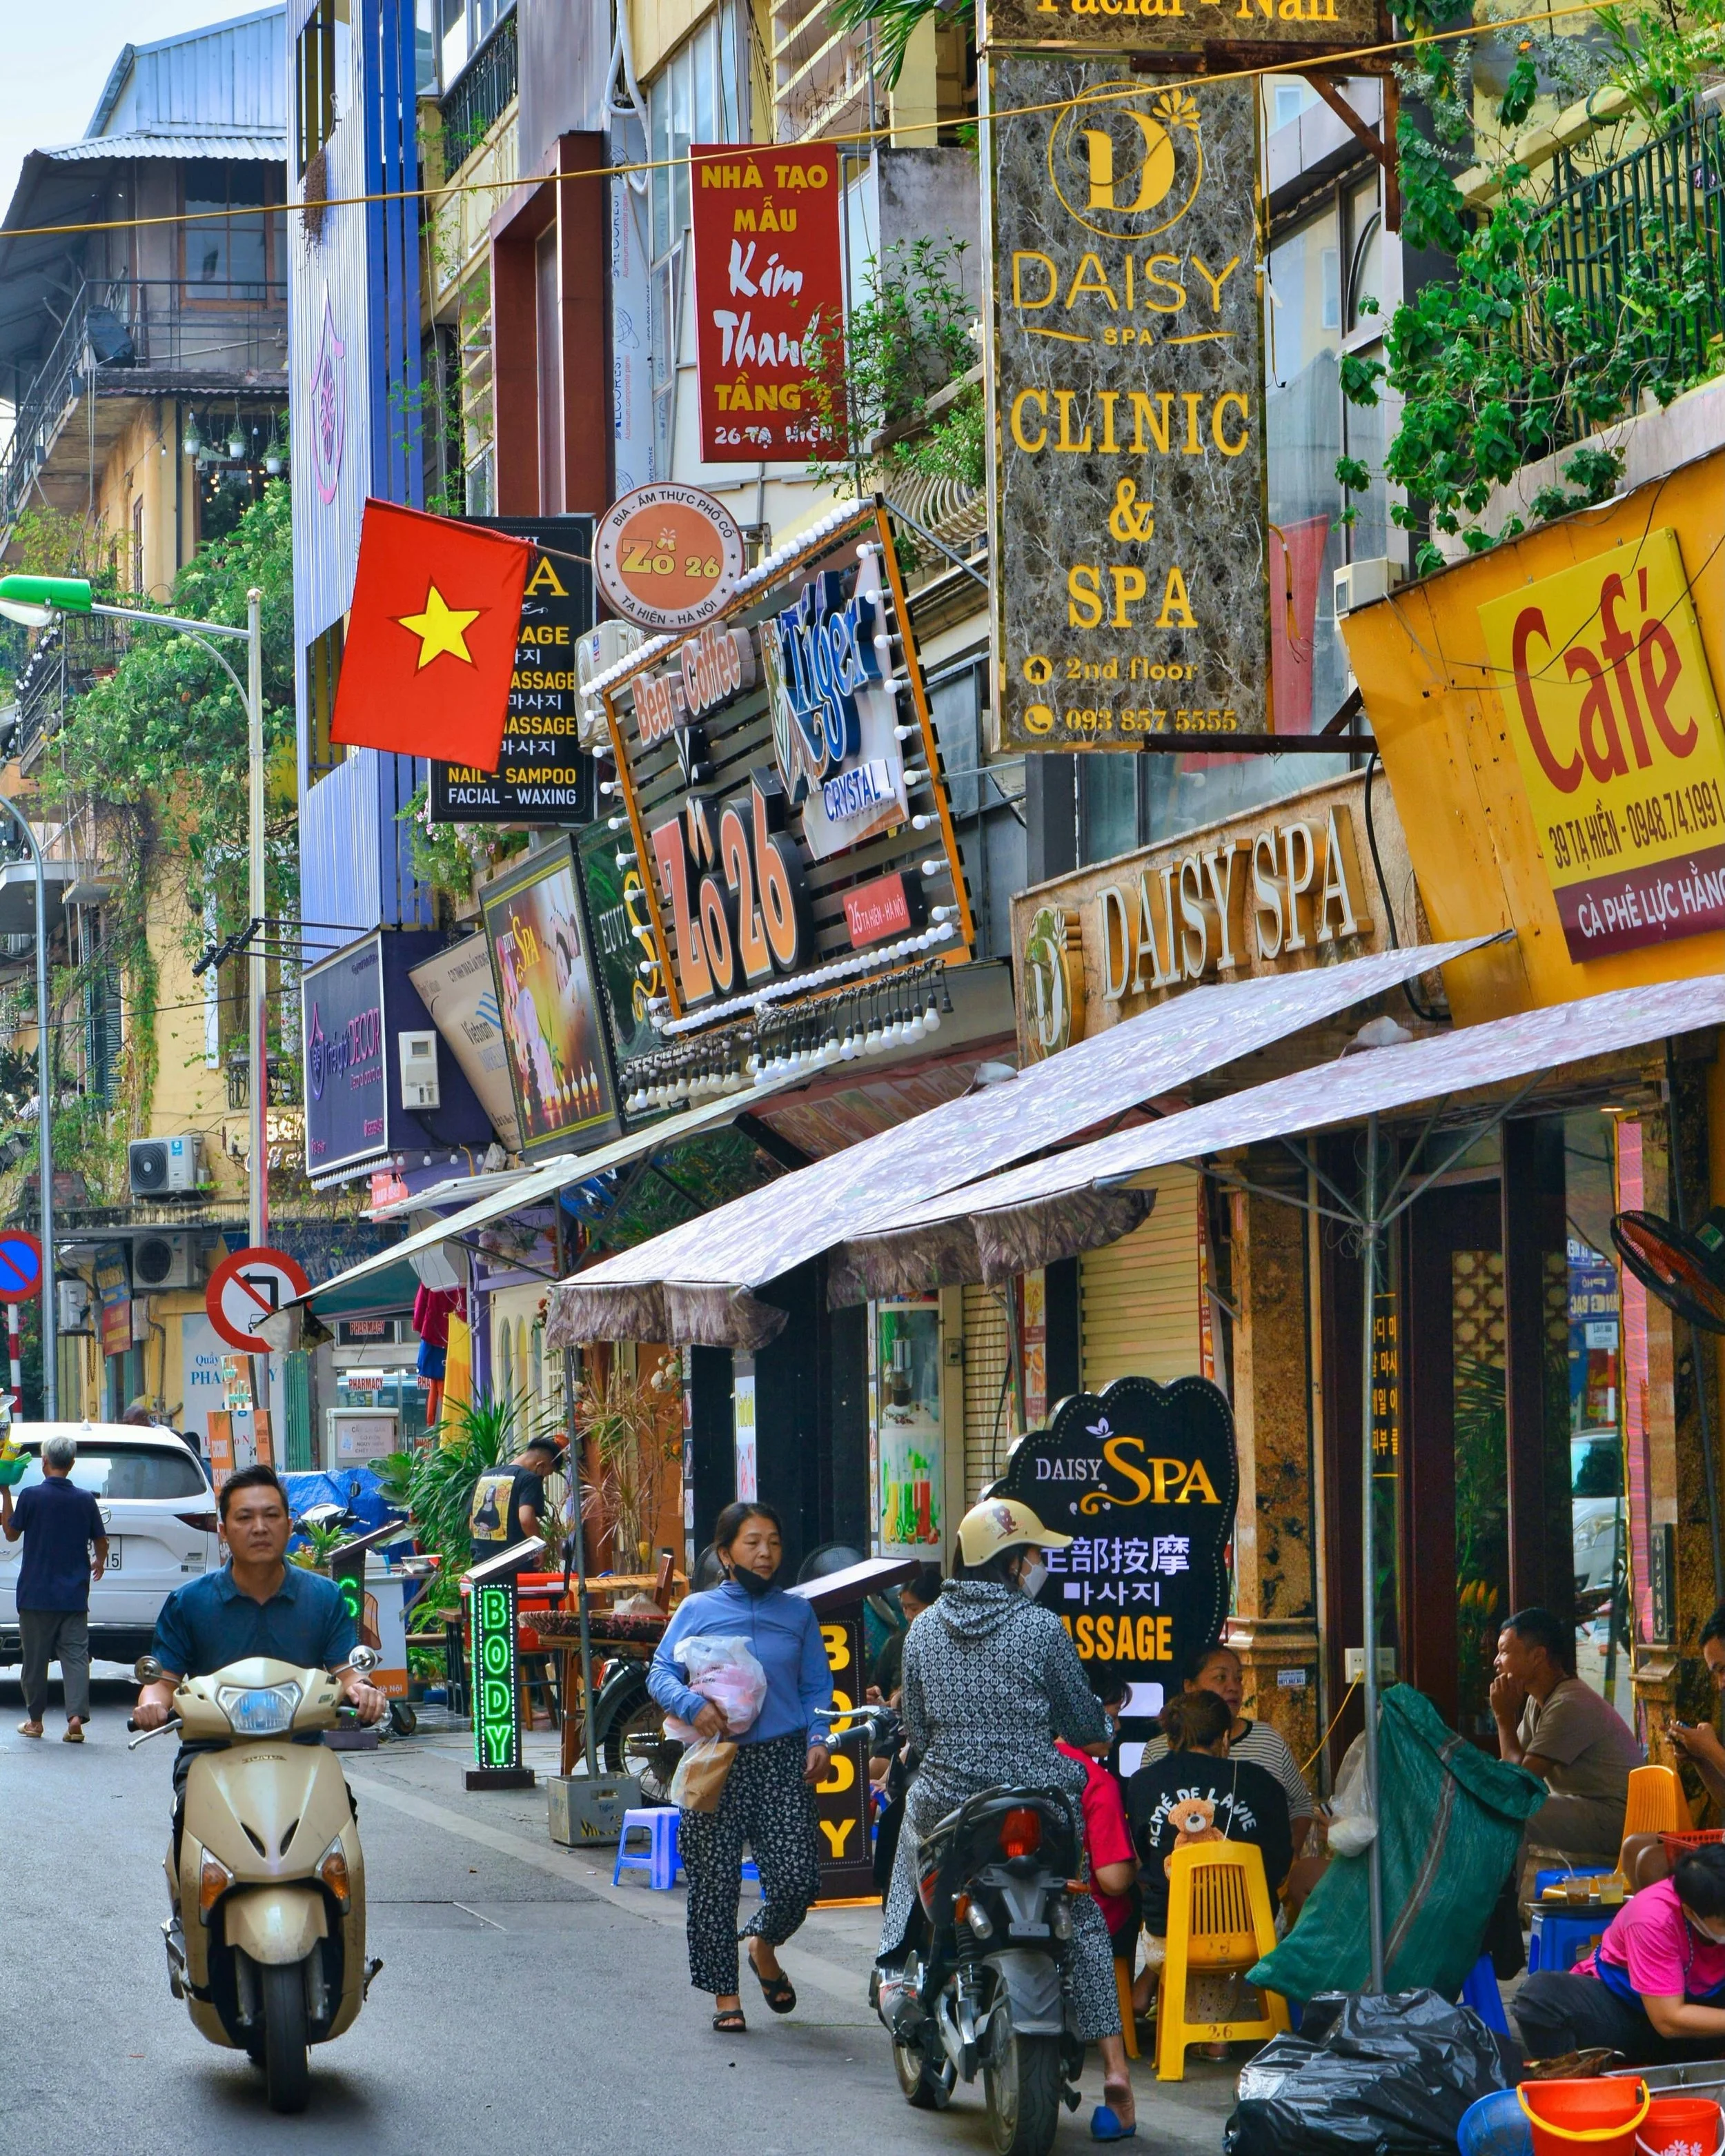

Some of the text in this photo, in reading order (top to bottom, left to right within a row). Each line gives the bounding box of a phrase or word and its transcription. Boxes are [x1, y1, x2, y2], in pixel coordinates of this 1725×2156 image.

[701, 157, 828, 194] NHÀ TẠO
[733, 195, 797, 232] MẪU
[1012, 250, 1240, 314] DAISY
[1103, 327, 1153, 346] SPA
[713, 371, 801, 411] TẦNG
[715, 426, 741, 445] 26
[1011, 389, 1249, 457] CLINIC
[612, 508, 631, 527] BIA
[659, 491, 696, 505] THỰC
[697, 500, 724, 520] PHỐ
[718, 521, 736, 538] CỔ
[1109, 477, 1154, 543] &
[684, 555, 721, 579] 26
[622, 595, 634, 613] TẠ
[637, 608, 666, 624] HIỆN
[678, 612, 696, 624] HÀ
[696, 600, 718, 618] NỘI
[1067, 564, 1199, 629] SPA
[511, 671, 575, 691] ASSAGE
[631, 673, 676, 746] Beer
[681, 626, 742, 716] Coffee
[780, 571, 869, 762] Tiger
[1065, 657, 1199, 681] 2nd floor
[1512, 566, 1699, 793] Café
[504, 716, 576, 735] ASSAGE
[1065, 709, 1237, 732] 093 857 5555
[448, 767, 486, 784] NAIL
[506, 768, 576, 784] SAMPOO
[448, 788, 500, 804] FACIAL
[516, 788, 576, 805] WAXING
[823, 763, 881, 822] CRYSTAL
[1548, 824, 1571, 869] 39
[1566, 819, 1590, 871] TẠ
[1626, 778, 1725, 849] 0948.74.1991
[720, 782, 796, 980] 26
[1096, 805, 1363, 1002] DAISY SPA
[599, 904, 630, 954] EUVI
[848, 900, 862, 935] 26
[885, 898, 895, 921] HÀ
[893, 893, 906, 922] NỘI
[1578, 893, 1606, 938] CÀ
[1602, 883, 1643, 933] PHÊ
[1640, 878, 1680, 931] LỰC
[512, 916, 541, 983] SPA
[348, 1007, 379, 1067] DECOR
[460, 1020, 495, 1045] Vietnam
[350, 1321, 386, 1336] PHARMACY
[348, 1377, 384, 1391] PHARMACY
[1036, 1436, 1222, 1515] DAISY SPA
[1063, 1581, 1160, 1607] 마사지
[1061, 1615, 1172, 1661] SSAGE
[389, 1685, 403, 1694] Nội
[483, 1590, 510, 1763] BODY
[1176, 1787, 1201, 1803] DE
[1233, 1801, 1257, 1832] VIE
